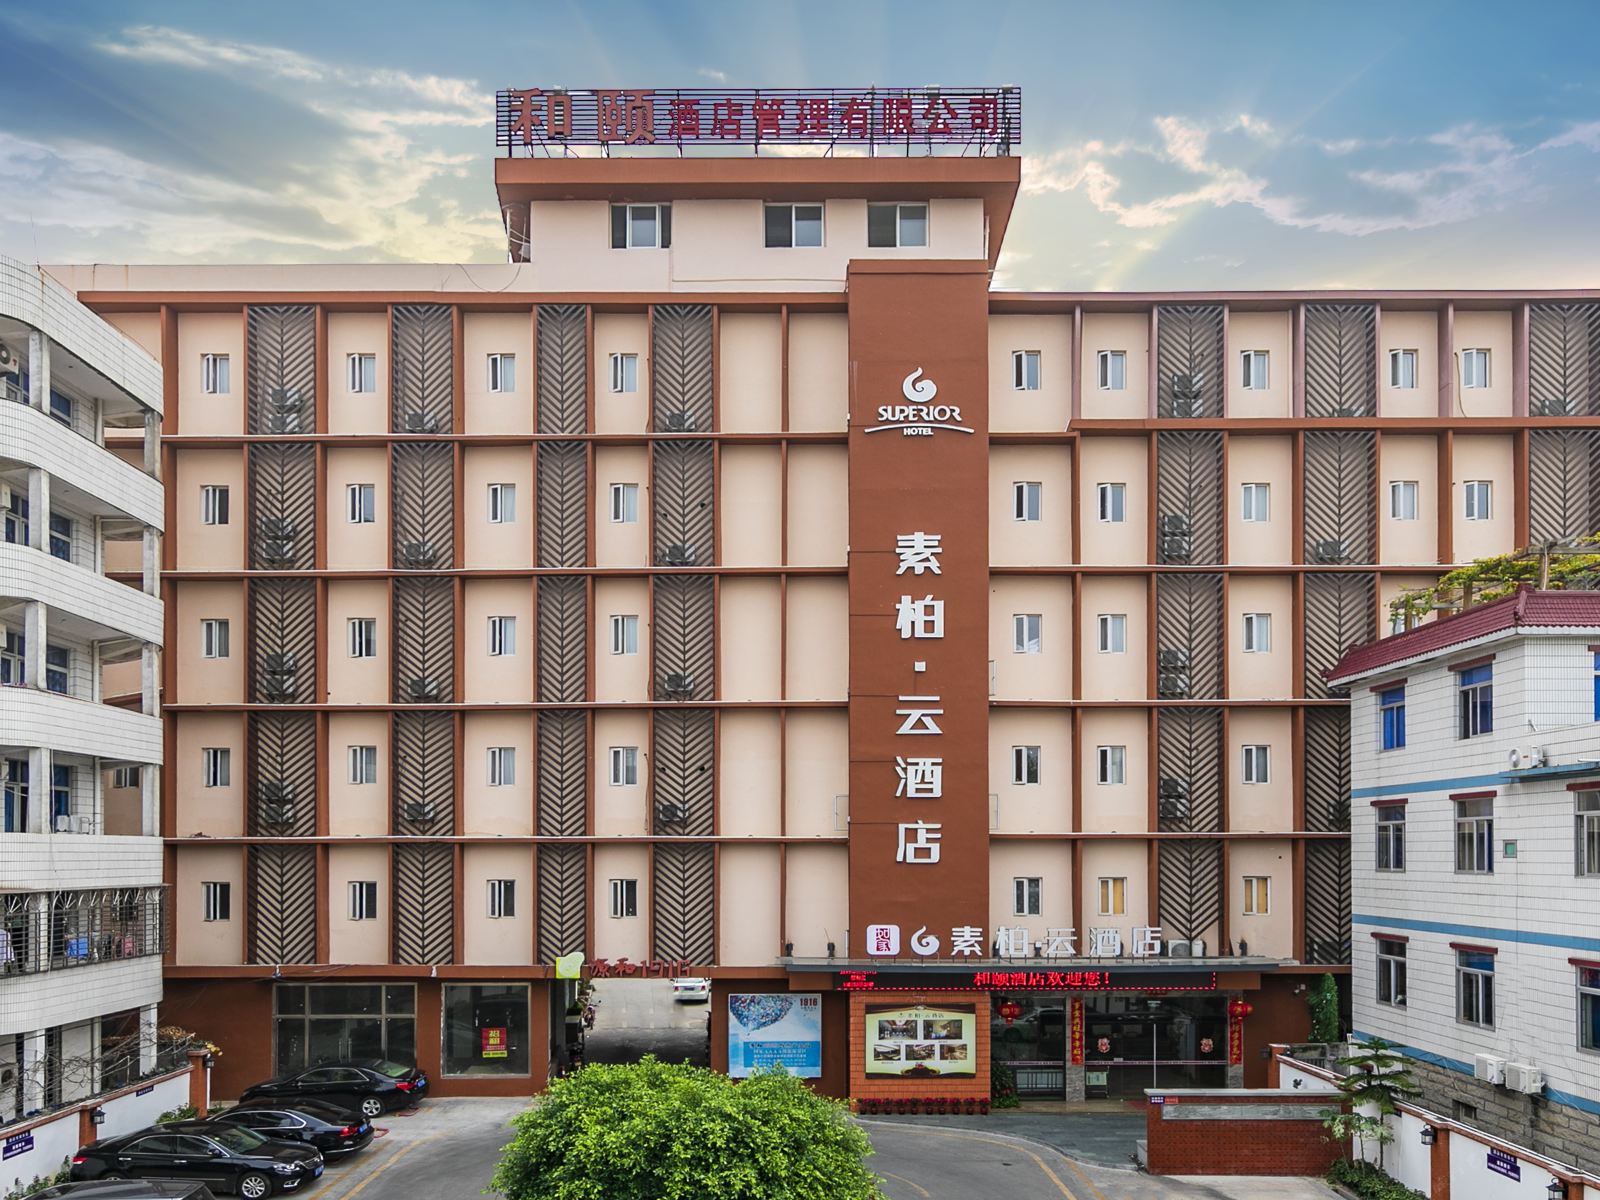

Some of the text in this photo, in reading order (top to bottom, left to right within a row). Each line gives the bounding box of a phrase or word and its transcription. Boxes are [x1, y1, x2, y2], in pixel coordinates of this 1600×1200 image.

[878, 405, 962, 422] SUPERIOR
[903, 427, 934, 436] HOTEL
[895, 531, 945, 864] 素柏·云酒店
